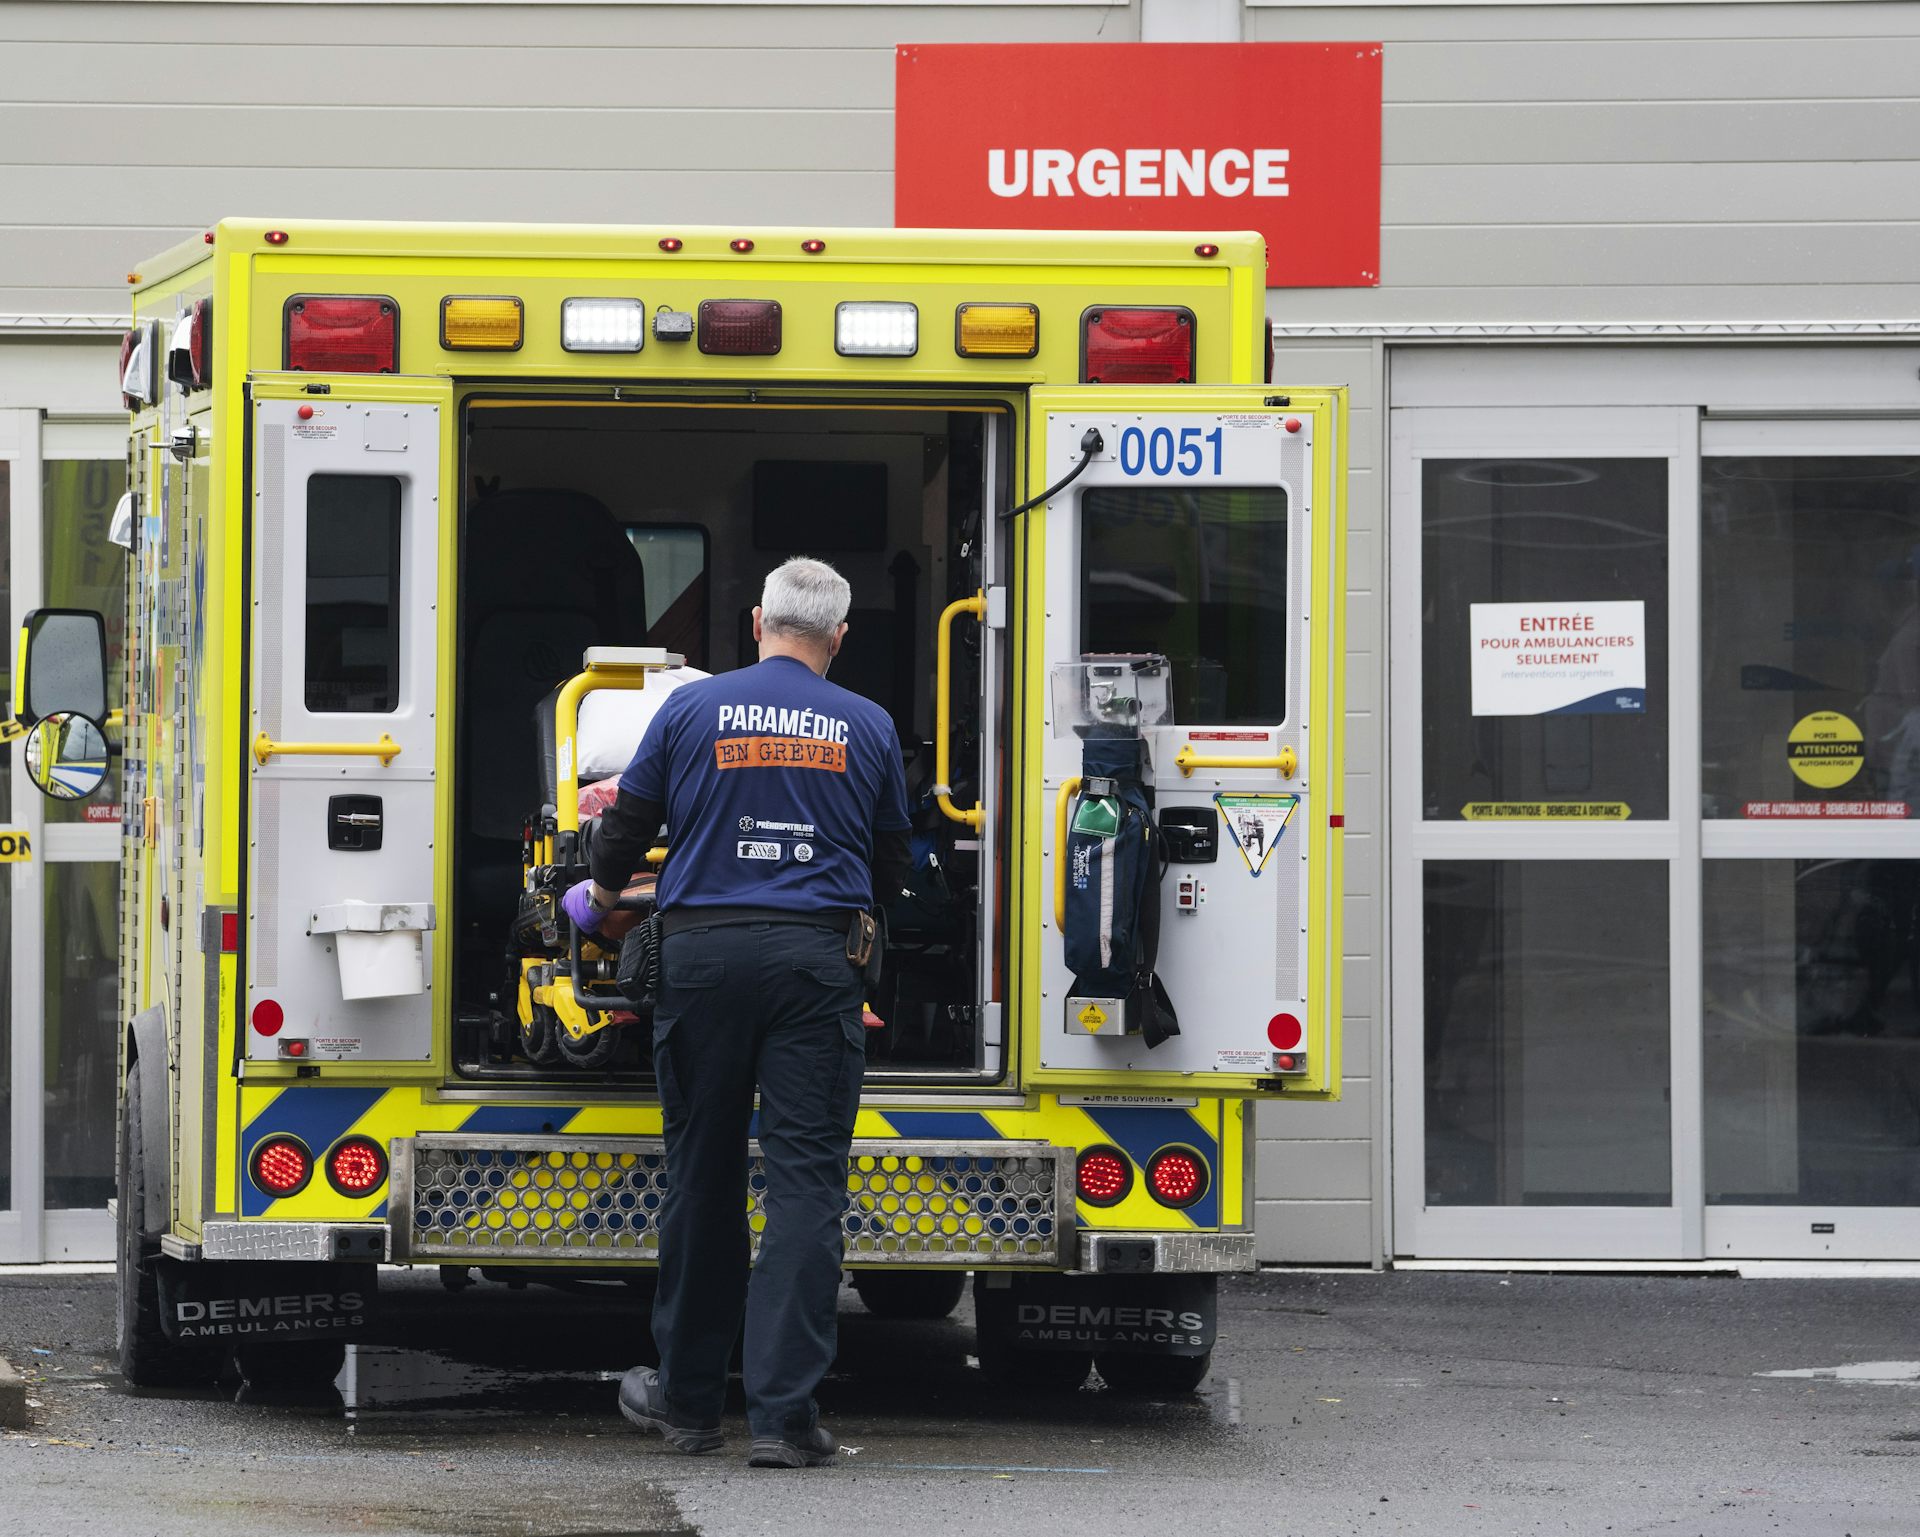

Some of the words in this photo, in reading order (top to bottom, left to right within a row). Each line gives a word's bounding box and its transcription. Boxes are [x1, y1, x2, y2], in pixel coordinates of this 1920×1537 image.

[988, 148, 1290, 198] URGENCE
[1120, 426, 1222, 476] 0051
[1520, 612, 1595, 632] ENTRÉE
[1481, 638, 1520, 649] POUR
[1524, 636, 1635, 649] AMBULANCIERS
[1516, 653, 1600, 665] SEULEMENT
[1501, 669, 1567, 680] interventions
[1569, 669, 1614, 681] urgentes
[718, 704, 849, 746] PARAMÉDIC
[719, 743, 750, 764] EN
[759, 738, 842, 767] GRÈVE!
[1795, 744, 1858, 754] ATTENTION
[1798, 759, 1854, 767] AUTOMATIQUE
[88, 806, 110, 818] PORTE
[1472, 805, 1493, 816] PORTE
[1494, 805, 1541, 816] AUTOMATIQUE
[1547, 805, 1581, 816] DEMEUREZ
[1589, 805, 1622, 816] DISTANCE
[1747, 803, 1771, 815] PORTE
[1771, 803, 1821, 815] AUTOMATIQUE
[1826, 803, 1864, 815] DEMEUREZ
[1871, 803, 1905, 815] DISTANCE
[756, 820, 815, 833] PRÉHOSPITALIER
[1090, 1094, 1102, 1102] Je
[1121, 1094, 1166, 1103] souviens
[177, 1292, 364, 1322] DEMERS
[1018, 1304, 1204, 1331] DEMERS
[180, 1315, 364, 1337] AMBULANCES
[1018, 1329, 1203, 1346] AMBULANCES
